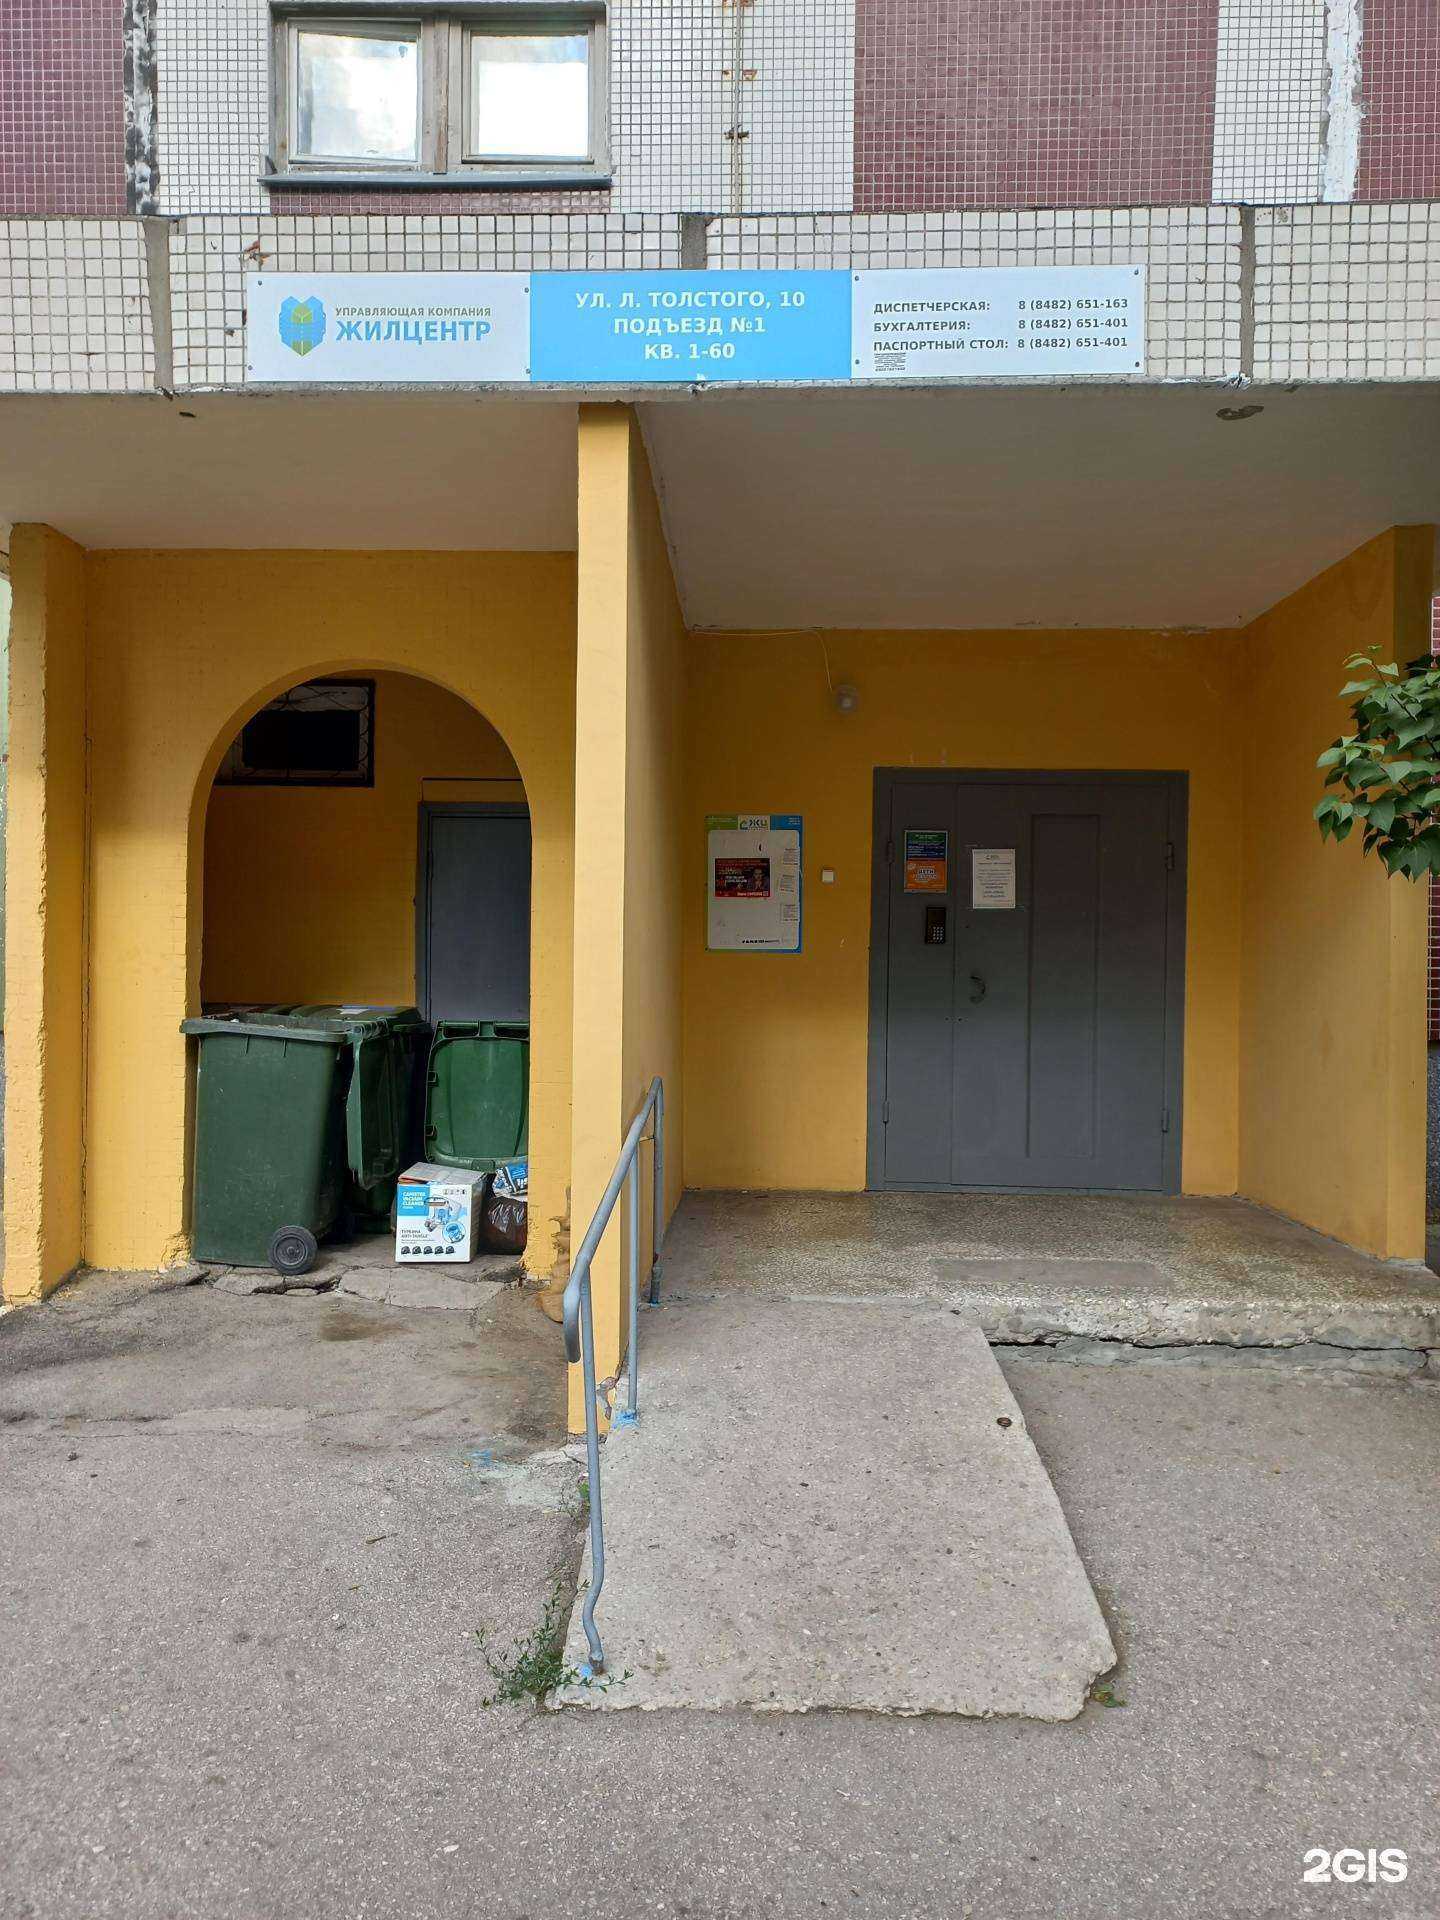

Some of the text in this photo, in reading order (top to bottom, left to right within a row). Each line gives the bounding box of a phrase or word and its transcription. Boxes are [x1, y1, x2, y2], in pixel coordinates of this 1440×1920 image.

[576, 291, 805, 309] УЛ. Л. ТОЛСТОГО, 10
[873, 298, 1128, 314] ДИСПЕТЧЕРСКАЯ: 8 (8482) 651-163
[335, 307, 491, 318] УПРАВЛЯЮЩАЯ КОМПАНИЯ
[336, 320, 491, 345] ЖИЛЦЕНТР
[613, 316, 766, 336] ПОДЪЕЗД №1
[873, 318, 1128, 332] БУХГАЛТЕРИЯ: 8 (8482) 651-401
[644, 342, 736, 360] КВ. 1-60
[873, 337, 1128, 351] ПАСПОРТНЫЙ СТОЛ: 8 (8482) 651-401
